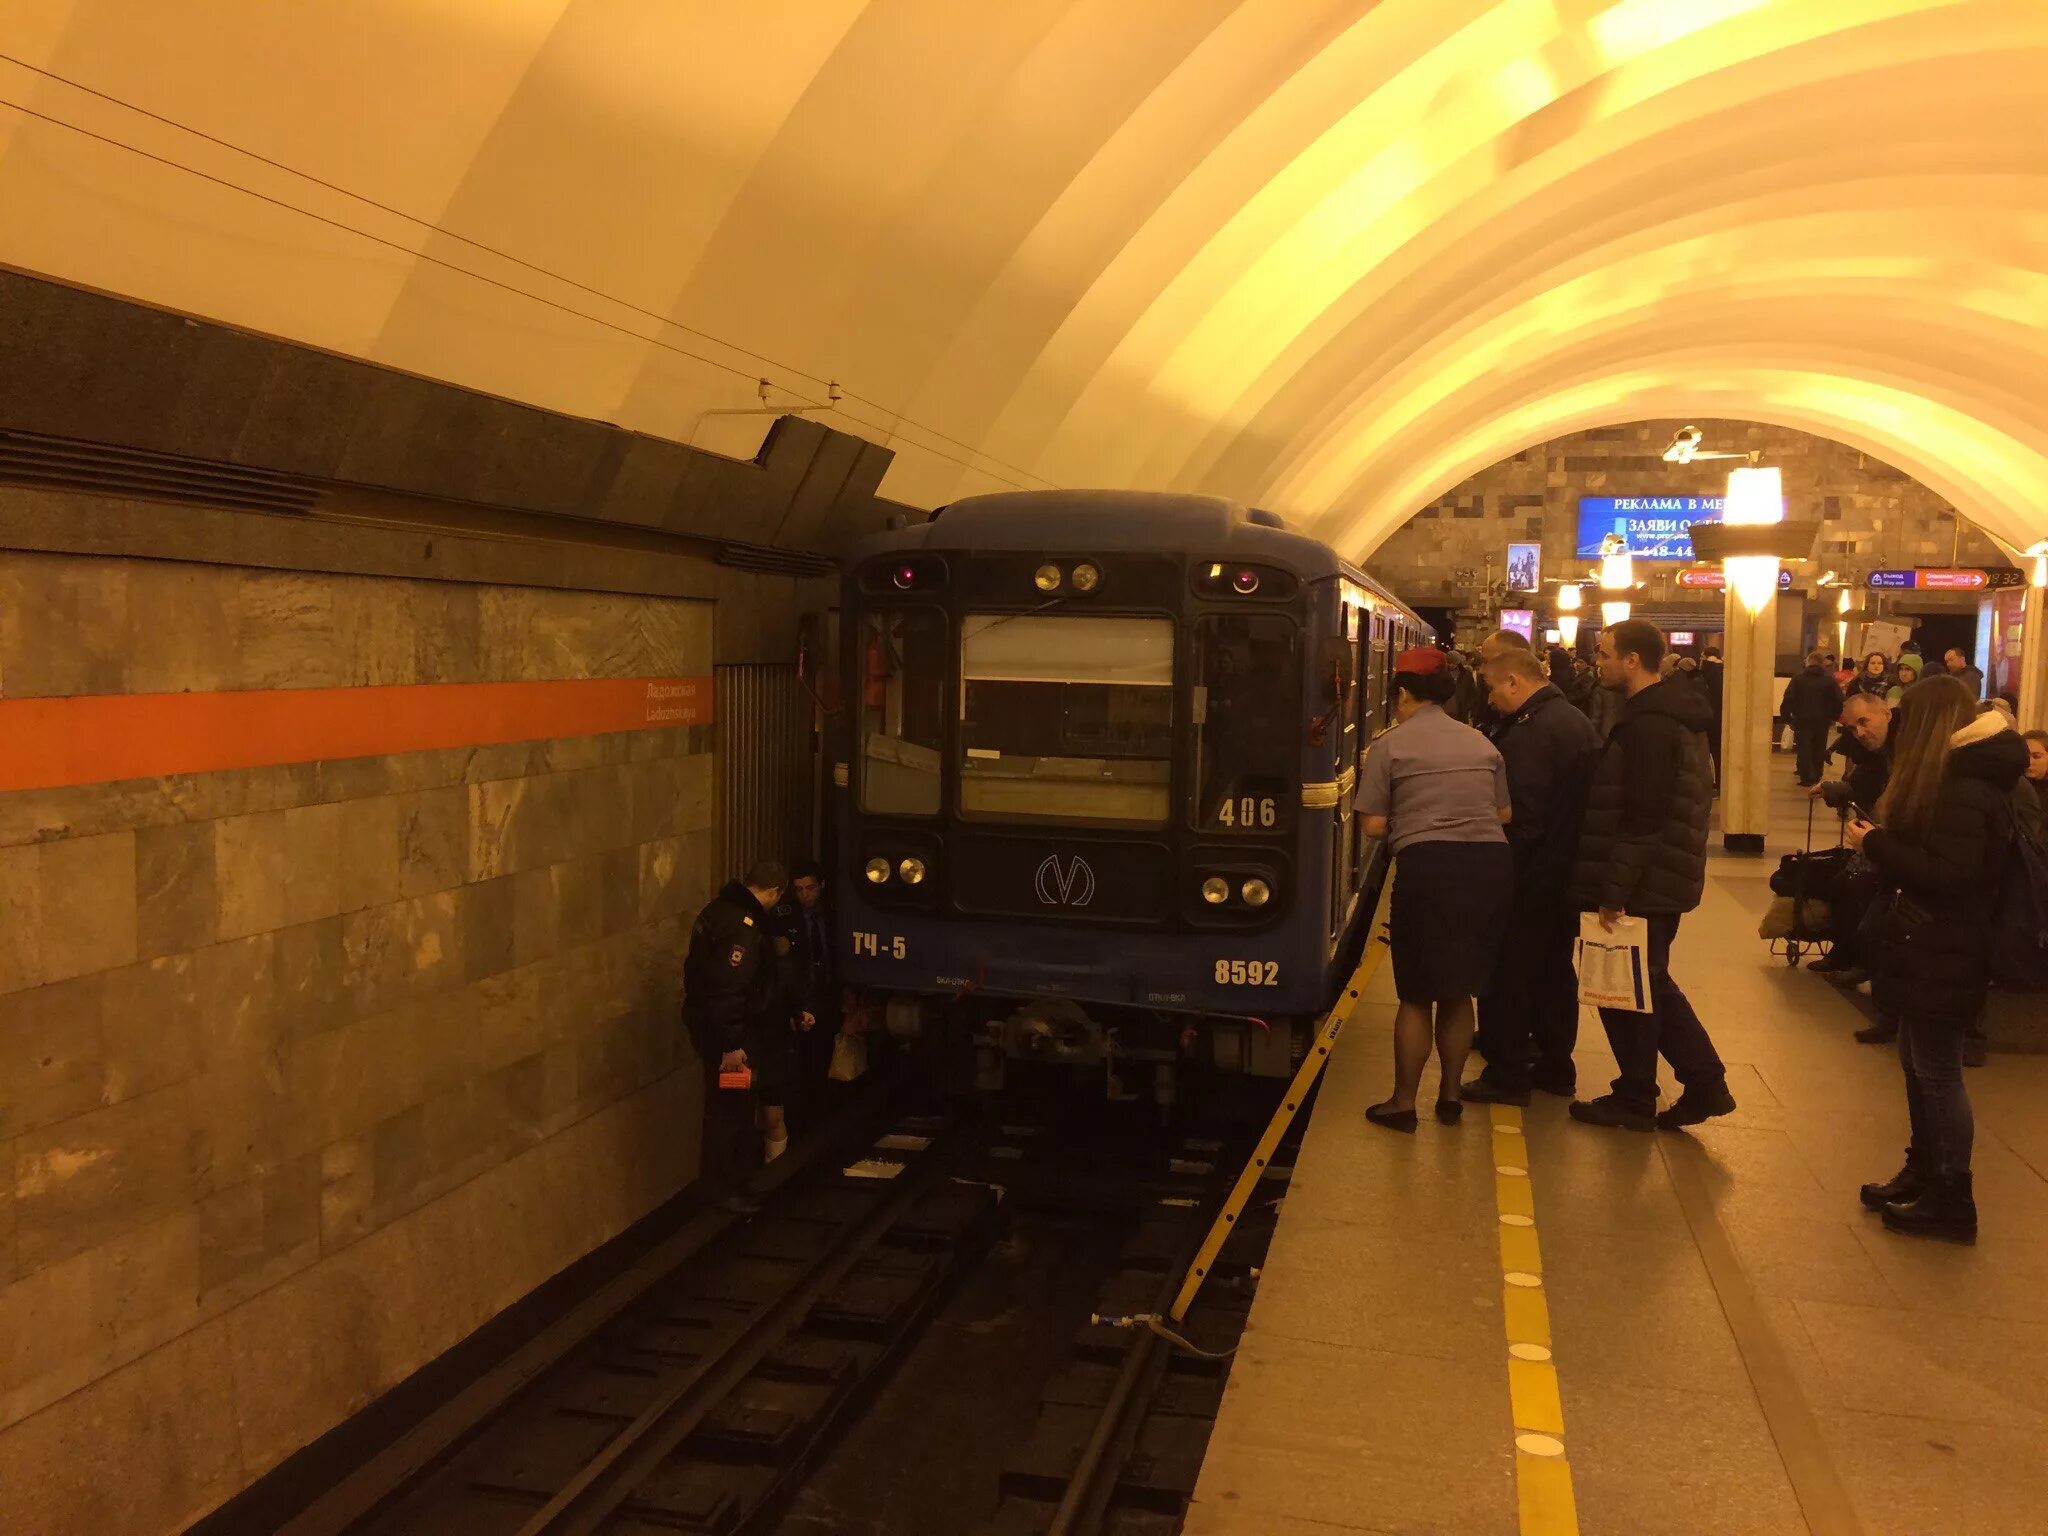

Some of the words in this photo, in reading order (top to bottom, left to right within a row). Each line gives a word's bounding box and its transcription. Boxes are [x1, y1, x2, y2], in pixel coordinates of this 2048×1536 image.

[1614, 498, 1682, 510] РЕКЛАМА
[1688, 498, 1697, 510] В
[1701, 498, 1725, 510] МЕ
[1628, 519, 1677, 532] ЗАЯВИ
[1218, 797, 1276, 828] 406
[852, 930, 907, 961] ТЧ-5
[1213, 959, 1279, 987] 8592
